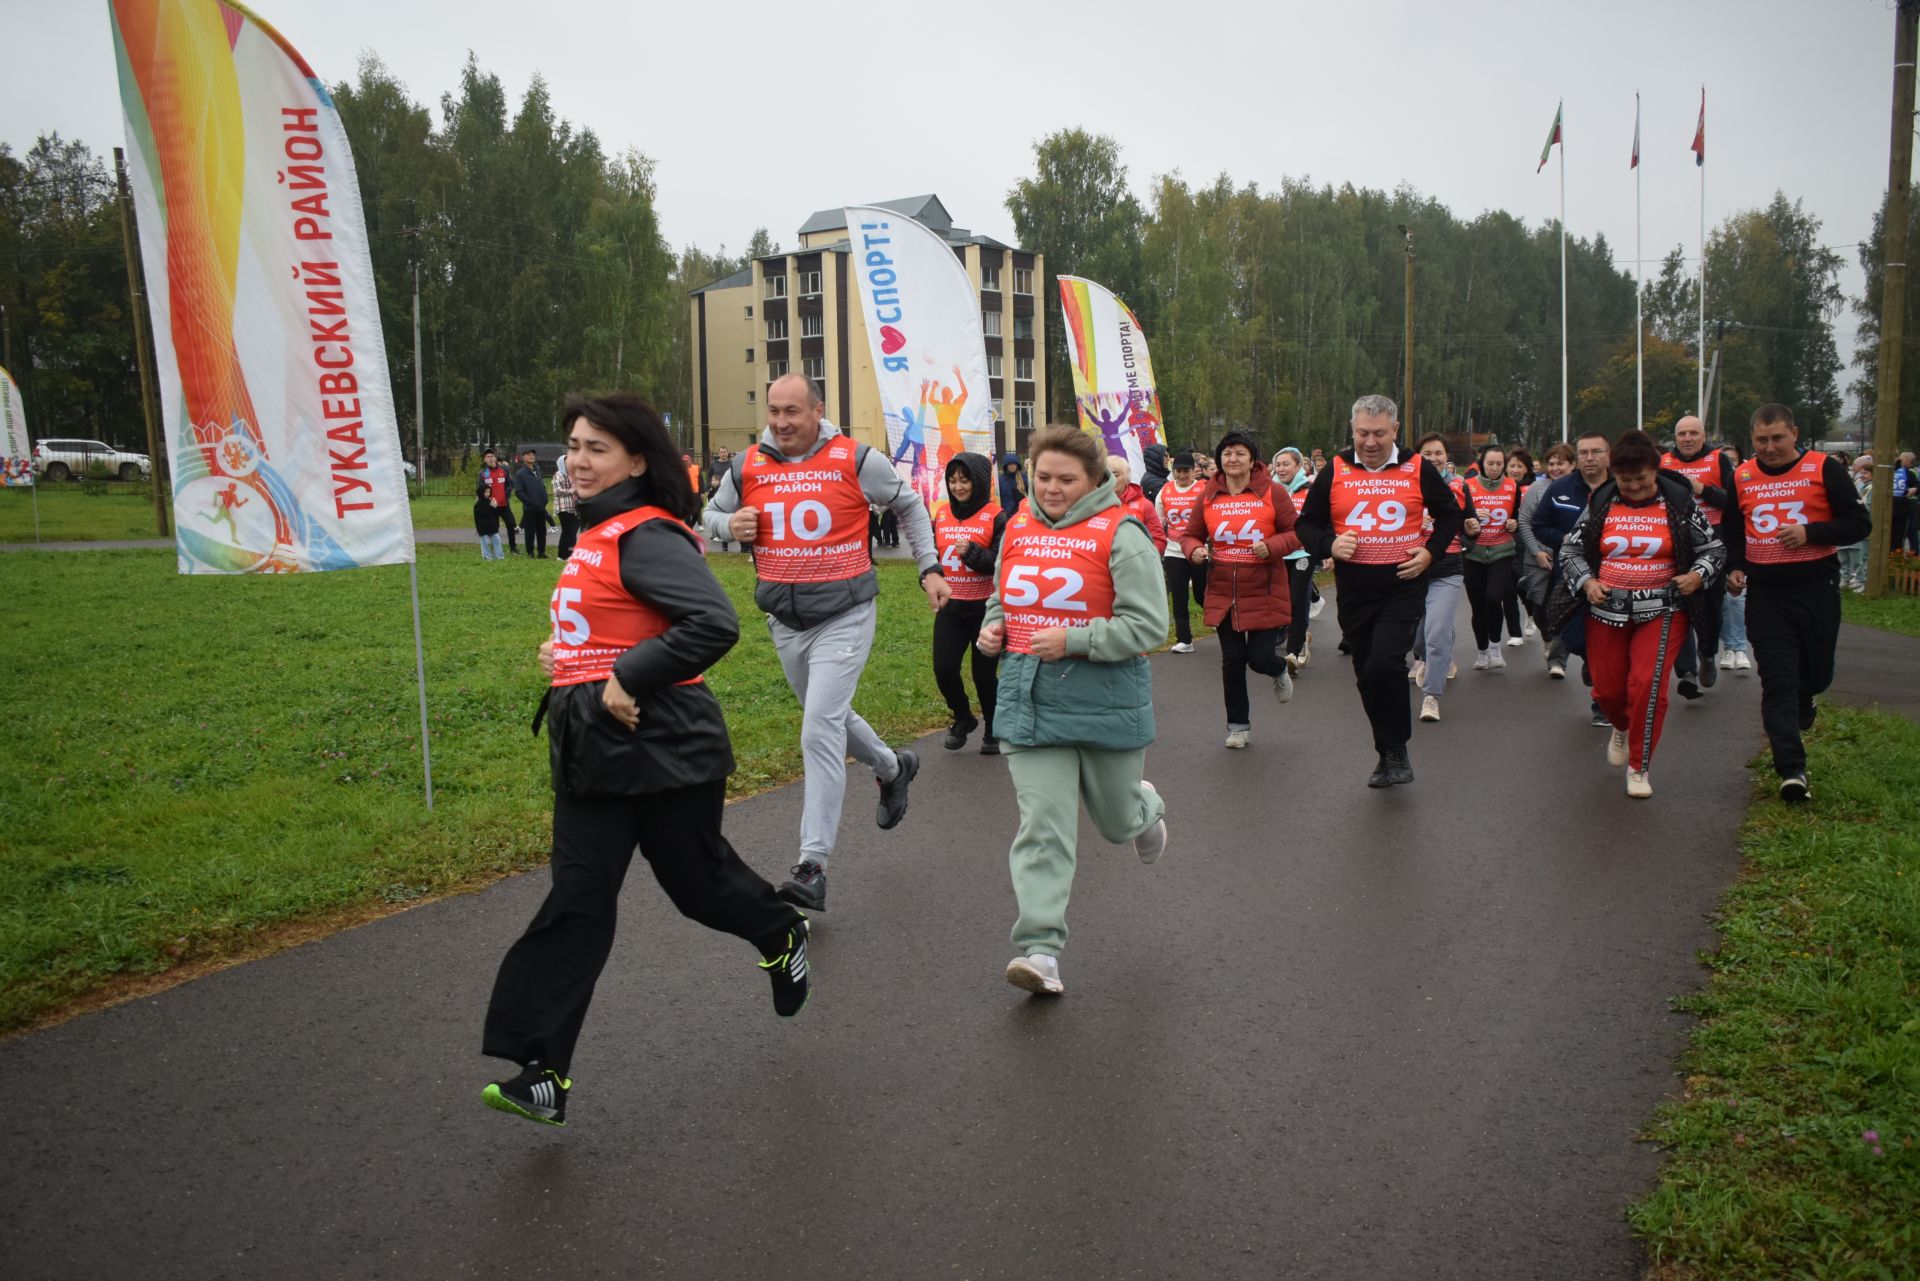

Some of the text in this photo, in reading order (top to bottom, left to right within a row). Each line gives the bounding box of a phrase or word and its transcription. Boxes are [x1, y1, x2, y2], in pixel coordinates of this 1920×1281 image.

[861, 222, 909, 372] Я СПОРТ!
[277, 107, 374, 520] ТУКАЕВСКИЙ РАЙОН
[1119, 321, 1135, 369] СПОРТА!
[756, 470, 843, 485] ТУКАЕВСКИЙ
[1344, 479, 1410, 489] ТУКАЕВСКИЙ
[774, 482, 823, 494] РАЙОН
[1357, 486, 1395, 495] РАЙОН
[1744, 479, 1810, 494] ТУКАЕВСКИЙ
[1757, 489, 1795, 499] РАЙОН
[1212, 501, 1263, 509] ТУКАЕВСКИЙ
[764, 500, 832, 541] 10
[1345, 500, 1407, 531] 49
[1605, 516, 1668, 525] ТУКАЕВСКИЙ
[1751, 501, 1808, 533] 63
[1214, 520, 1264, 544] 44
[1013, 535, 1097, 552] ТУКАЕВСКИЙ
[1357, 536, 1394, 544] НОРМА
[1602, 536, 1663, 559] 27
[776, 547, 823, 557] НОРМА
[824, 540, 863, 553] ЖИЗНИ
[1024, 546, 1072, 560] РАЙОН
[1614, 561, 1649, 571] НОРМА
[1003, 564, 1087, 612] 52
[1019, 613, 1069, 628] НОРМА
